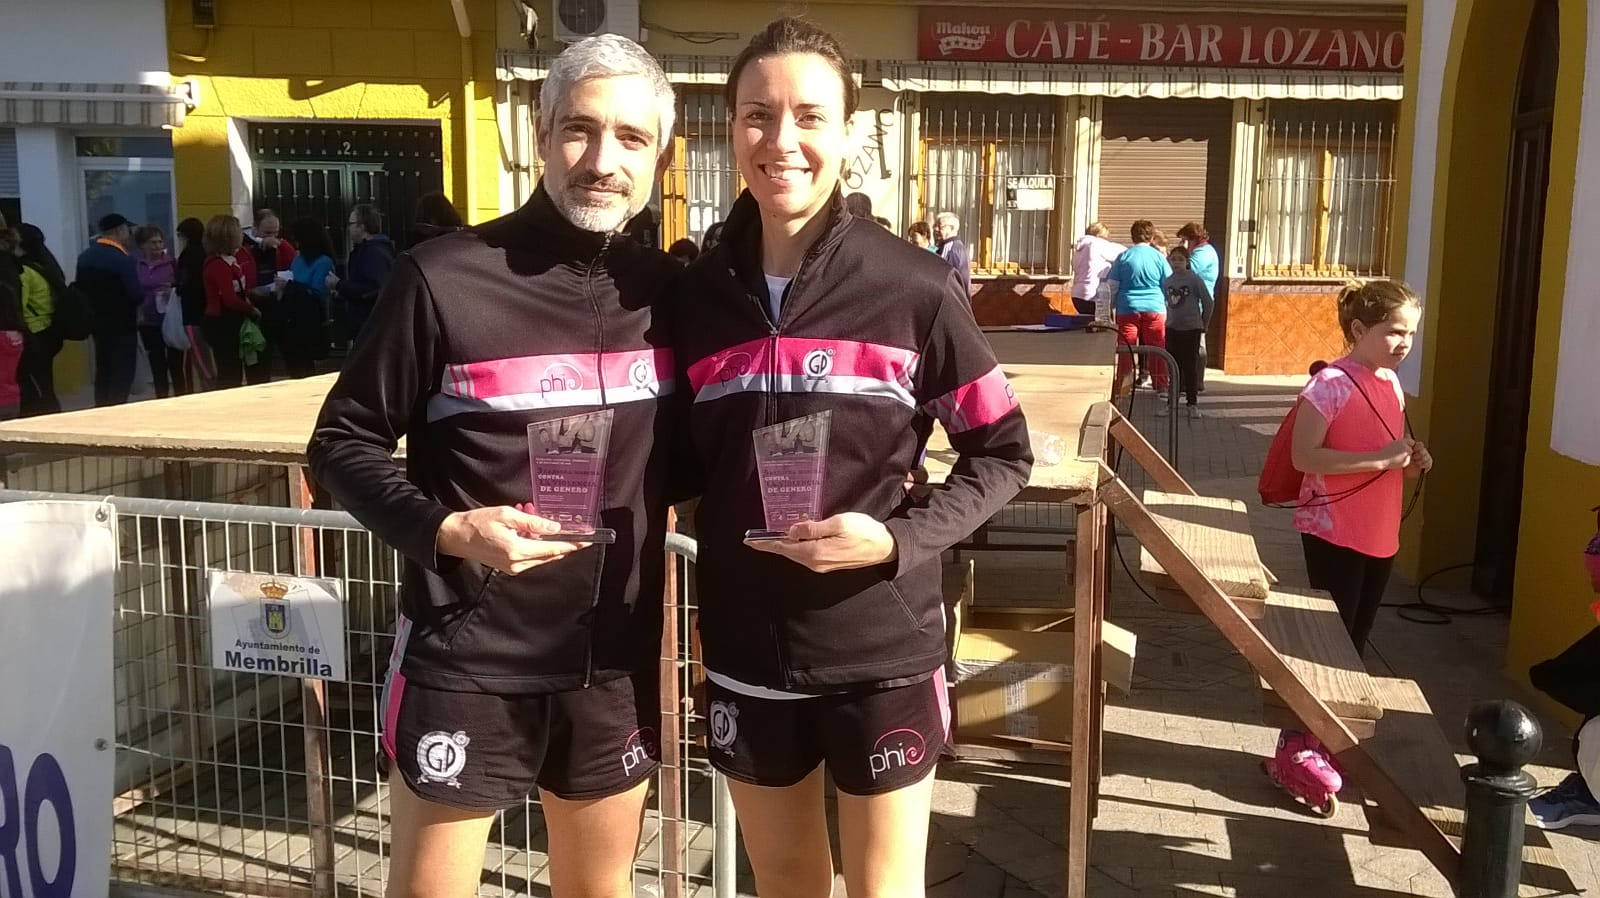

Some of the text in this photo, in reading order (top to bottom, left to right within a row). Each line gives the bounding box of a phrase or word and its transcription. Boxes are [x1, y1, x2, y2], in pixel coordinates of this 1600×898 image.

[935, 22, 991, 35] Mahou
[1005, 15, 1111, 60] CAFÉ
[1138, 22, 1224, 63] BAR
[1239, 26, 1406, 69] LOZANO
[342, 141, 351, 155] 2
[845, 108, 895, 190] OZANO
[1007, 177, 1054, 189] SE ALQUILA
[235, 639, 321, 655] Ayuntamiento de
[225, 650, 333, 677] Membrilla
